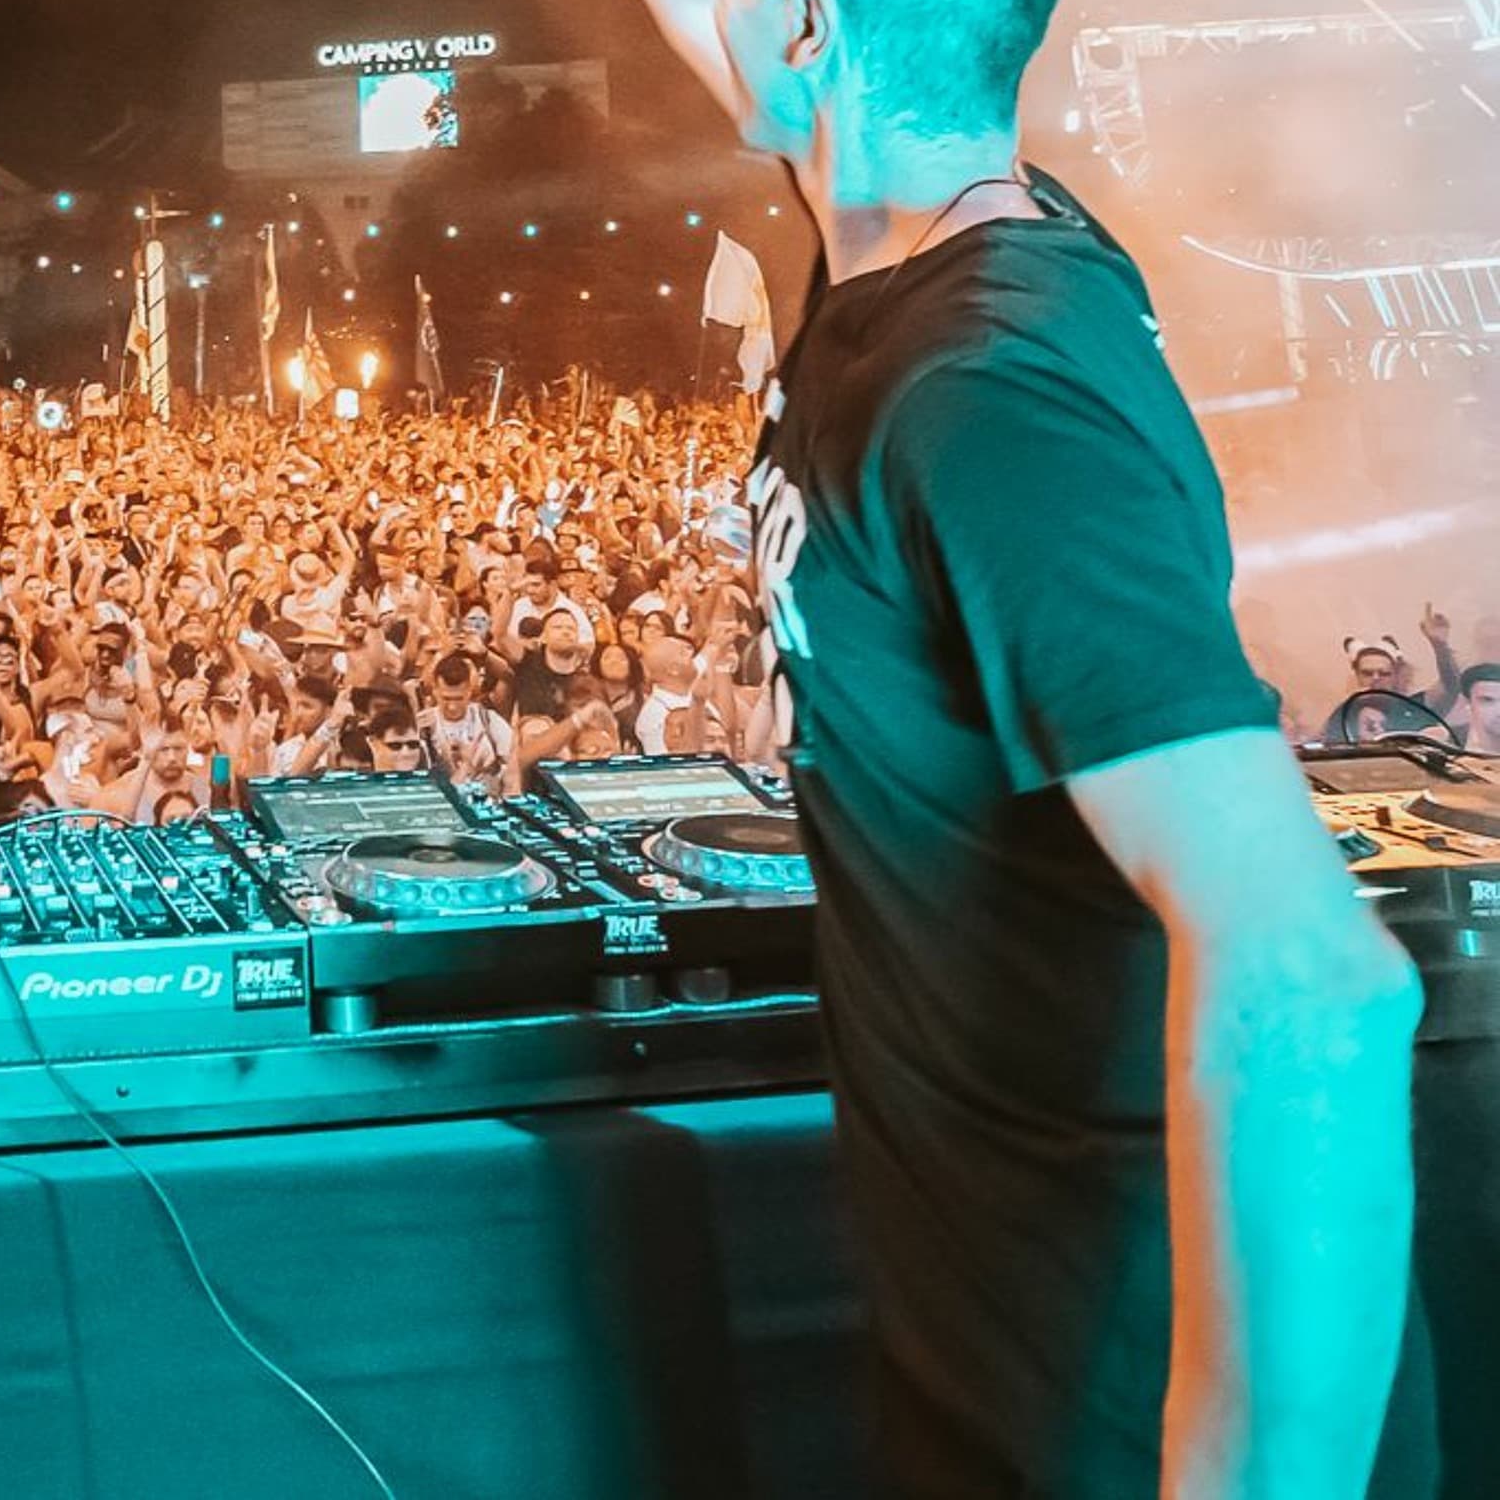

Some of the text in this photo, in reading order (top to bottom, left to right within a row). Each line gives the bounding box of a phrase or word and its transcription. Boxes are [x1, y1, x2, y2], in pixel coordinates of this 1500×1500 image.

[317, 40, 414, 67] CAMPING
[605, 915, 659, 937] TRUE
[236, 958, 295, 983] TRUE
[19, 971, 174, 1001] Pioneer
